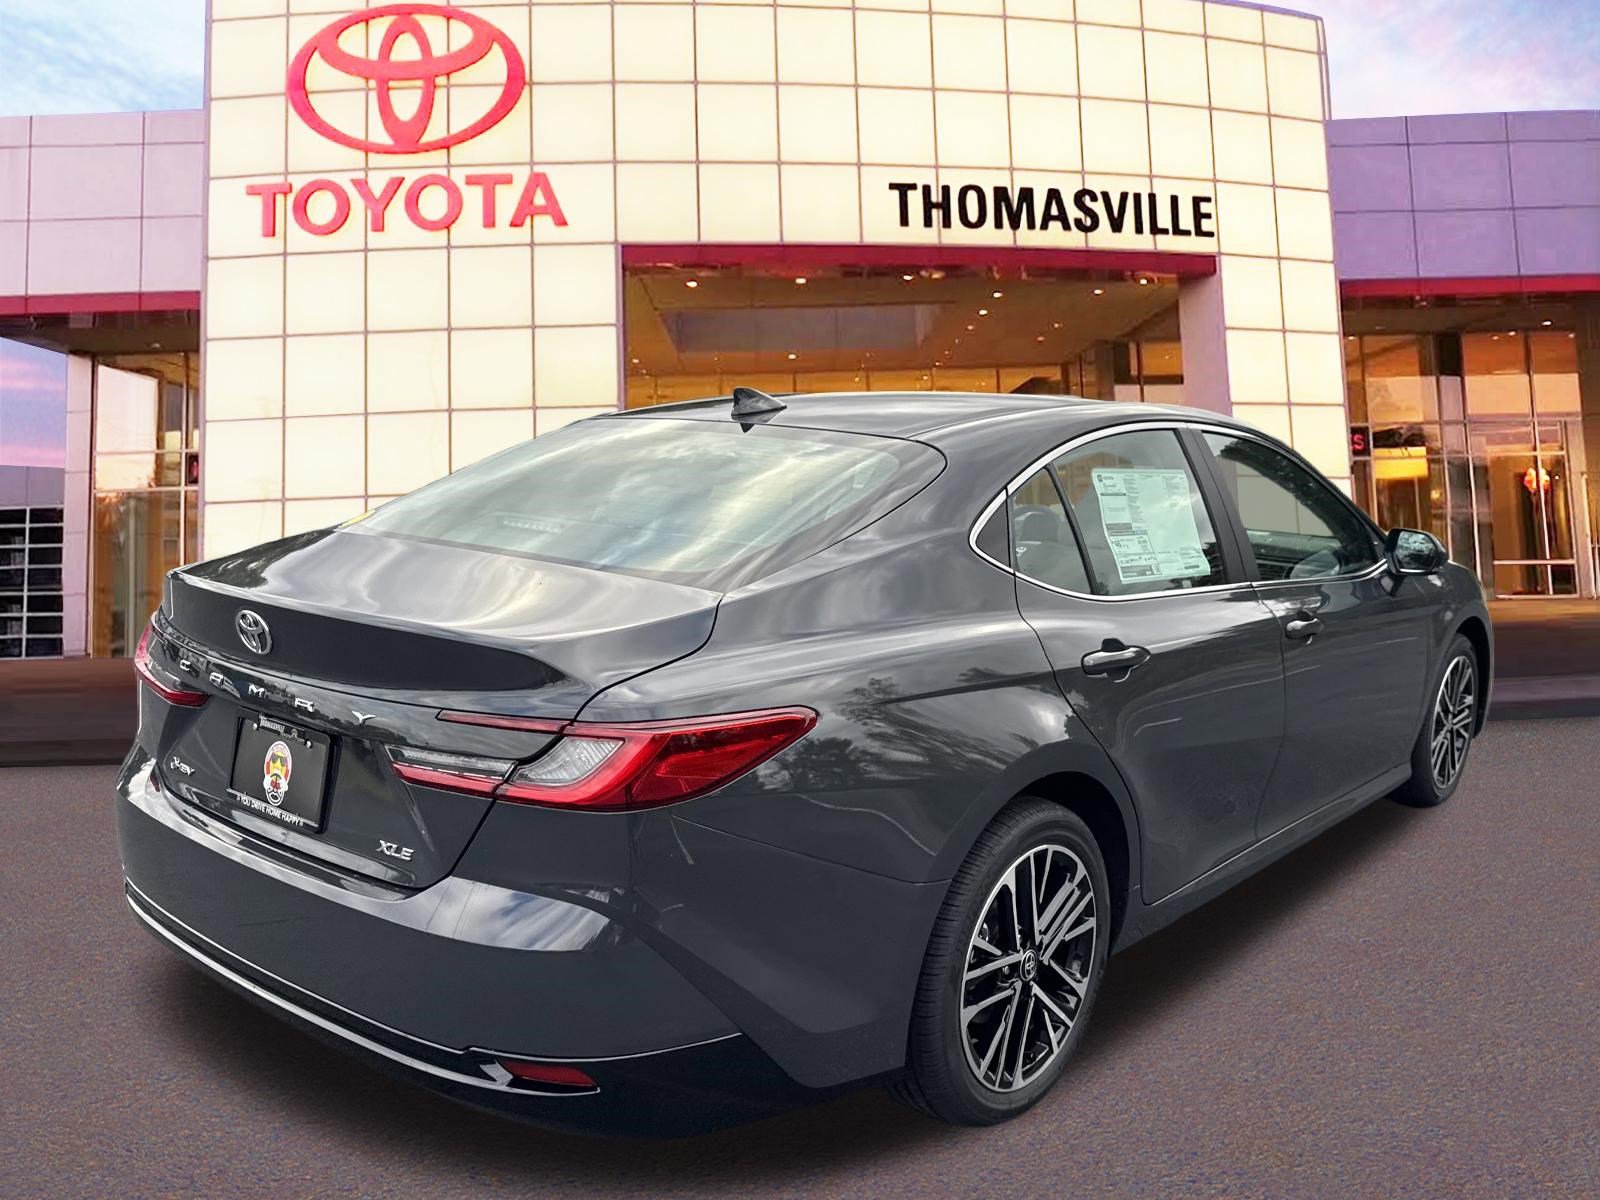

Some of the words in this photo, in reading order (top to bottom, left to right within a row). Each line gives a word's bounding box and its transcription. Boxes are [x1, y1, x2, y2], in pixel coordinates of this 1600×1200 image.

[246, 172, 569, 238] TOYOTA
[888, 182, 1217, 239] THOMASVILLE
[375, 839, 416, 861] XLE
